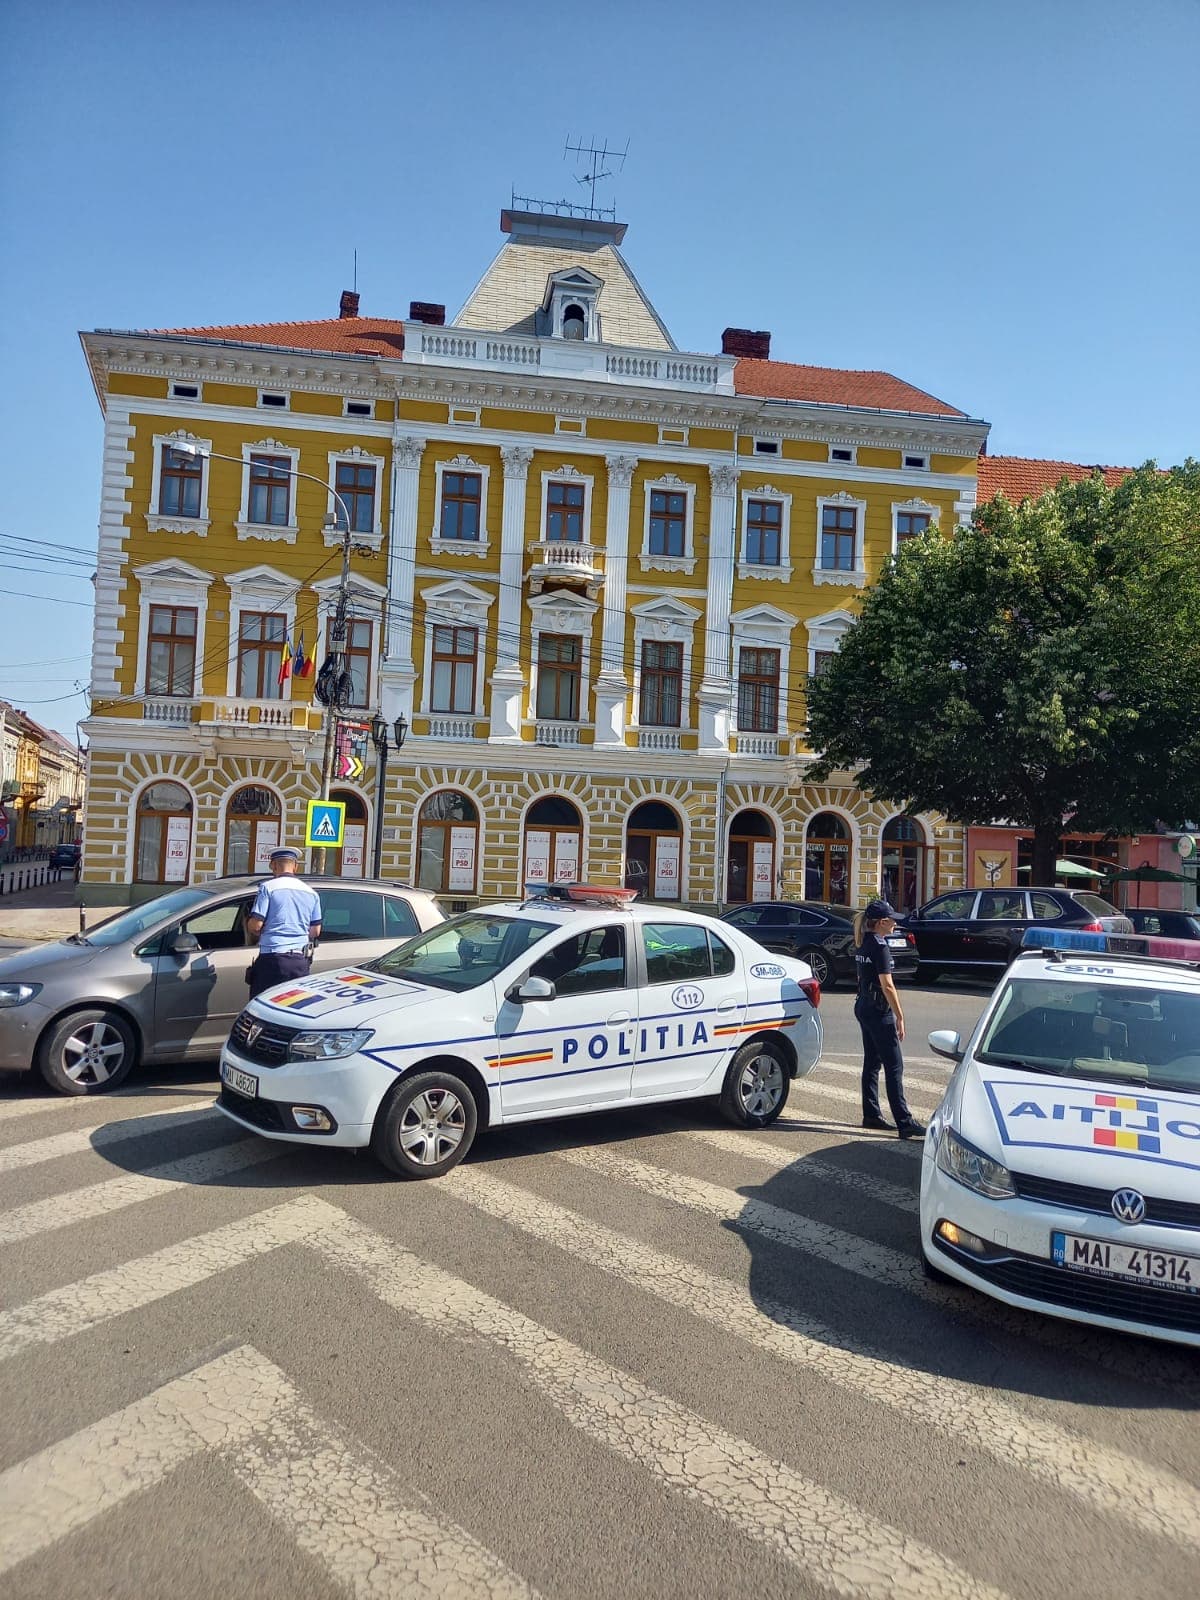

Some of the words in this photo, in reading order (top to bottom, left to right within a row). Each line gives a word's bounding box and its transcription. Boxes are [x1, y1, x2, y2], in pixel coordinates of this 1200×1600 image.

[530, 869, 544, 877] PSD
[559, 870, 573, 878] PSD
[1063, 965, 1114, 974] SM
[683, 992, 699, 1005] 112
[562, 1021, 709, 1064] POLITIA
[1053, 1248, 1064, 1260] RO
[1073, 1240, 1111, 1269] MAI
[1127, 1251, 1192, 1283] 41314
